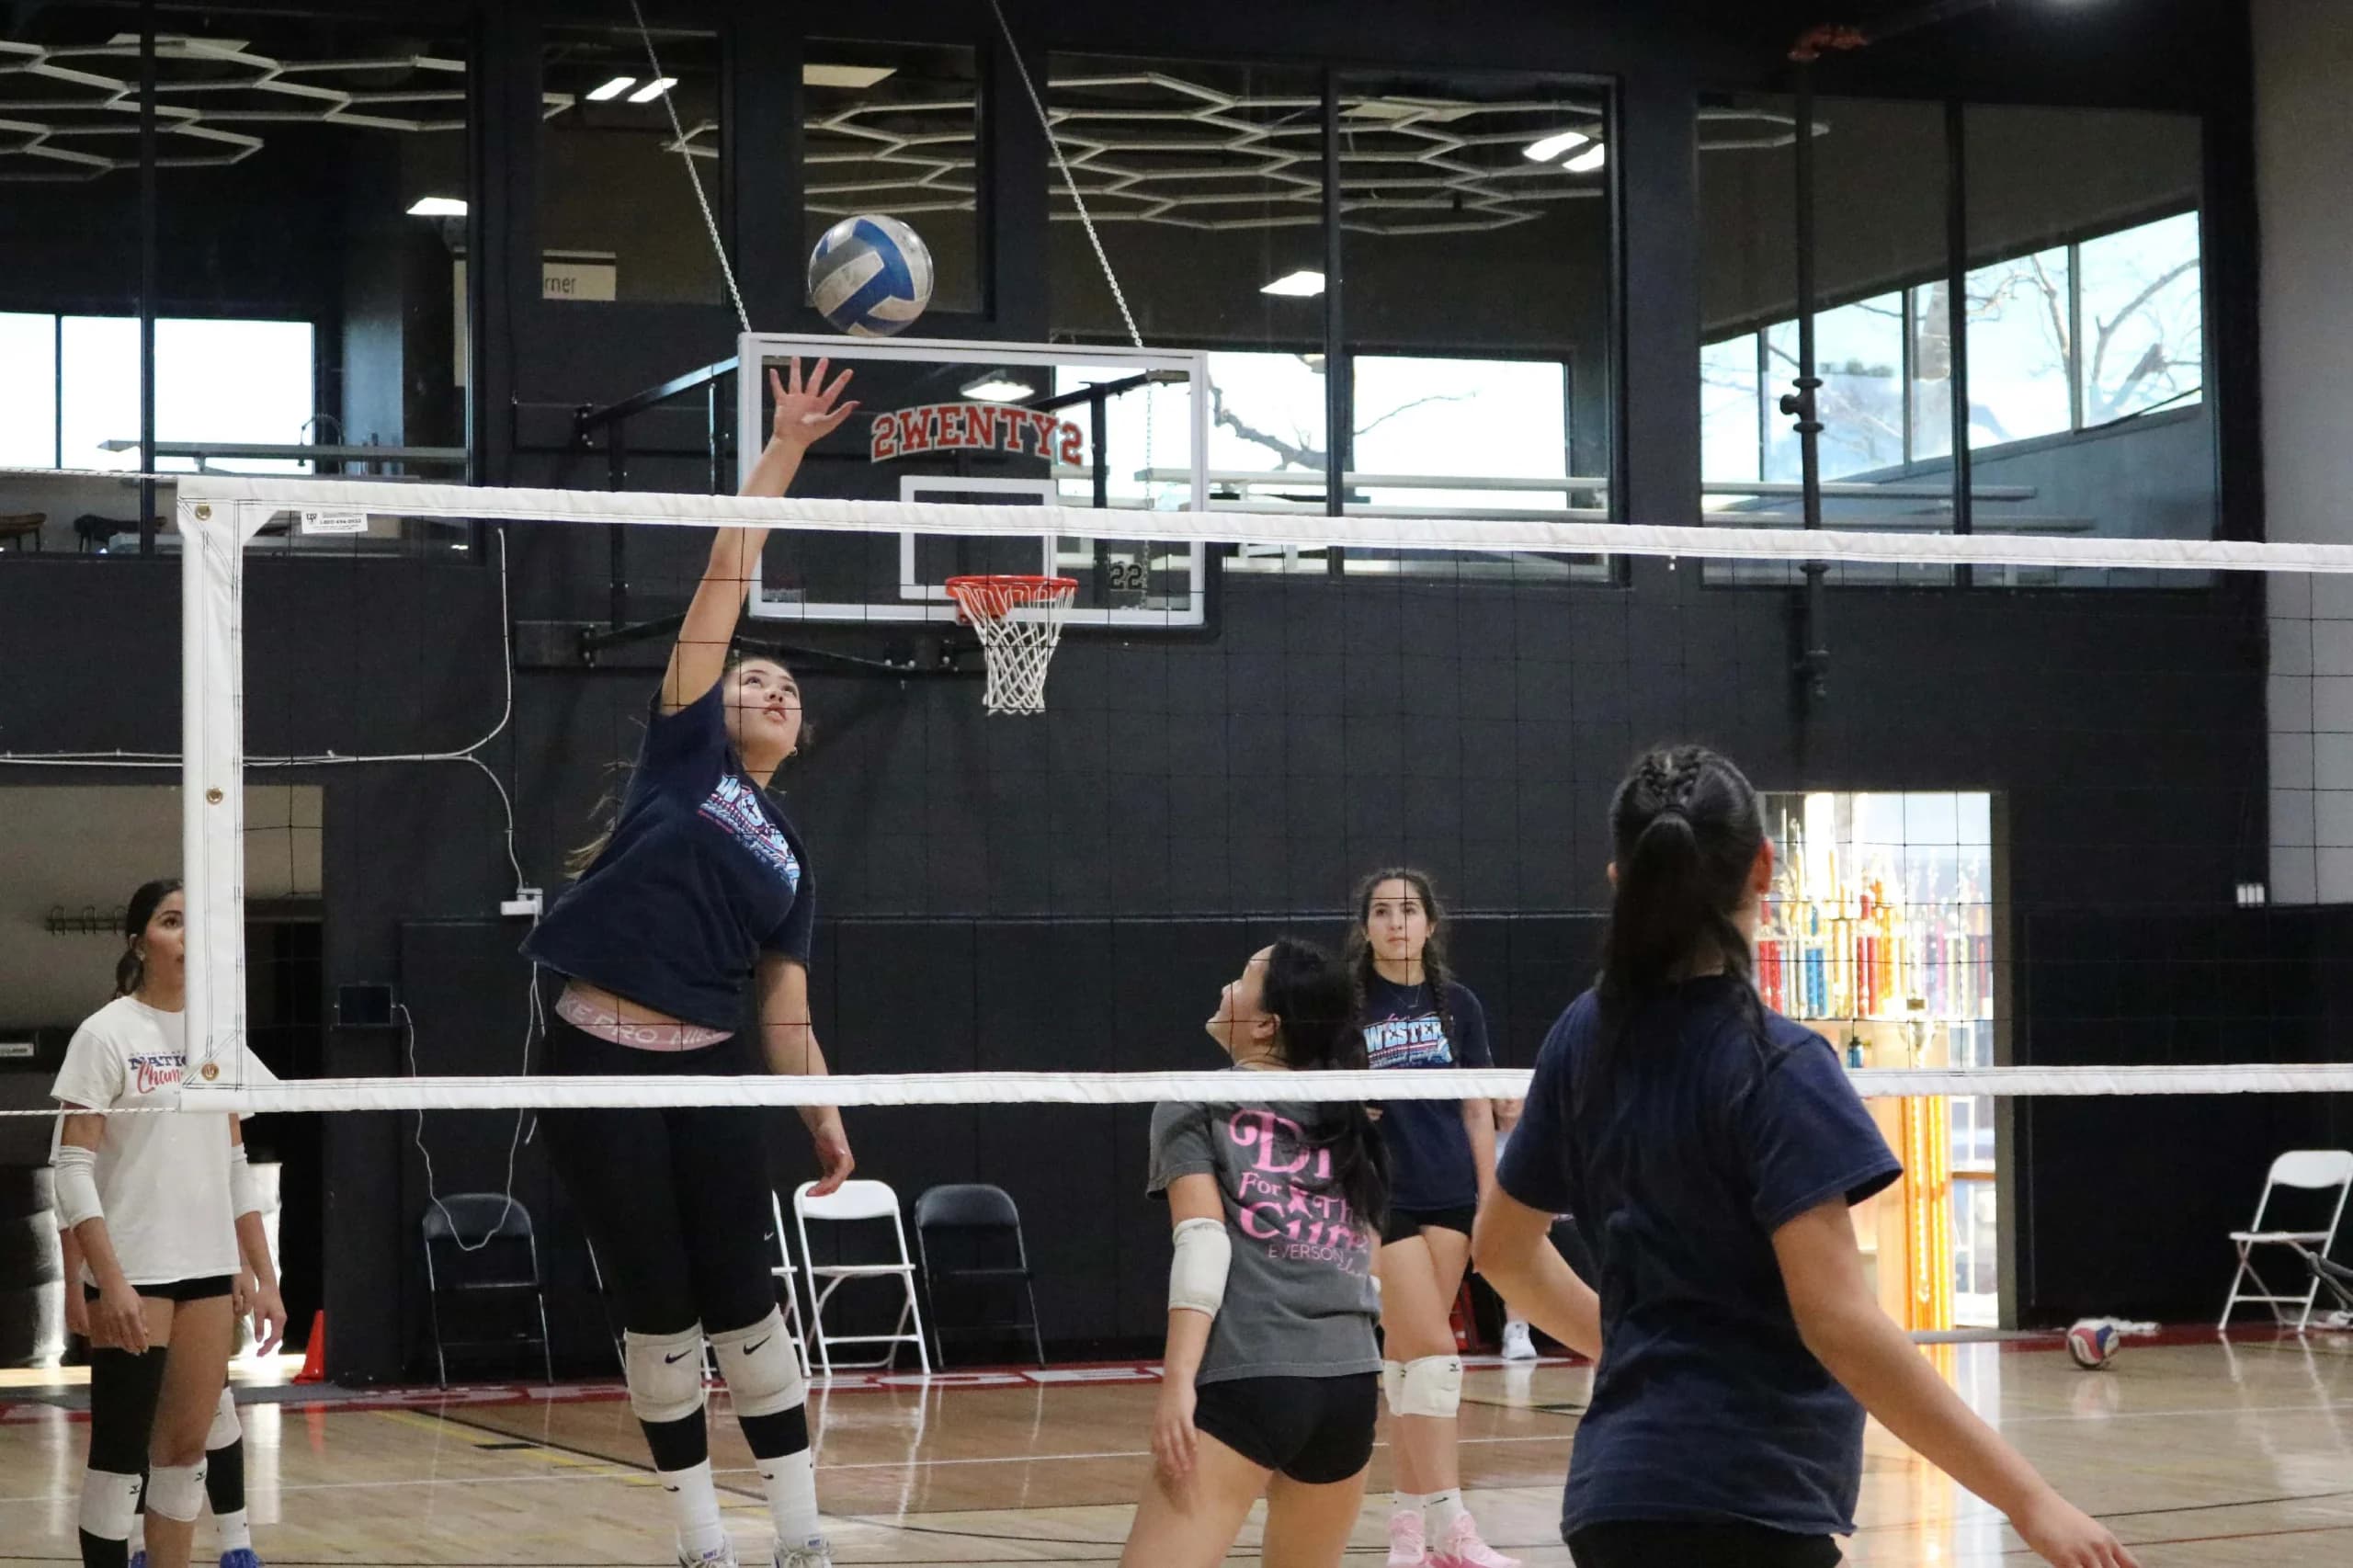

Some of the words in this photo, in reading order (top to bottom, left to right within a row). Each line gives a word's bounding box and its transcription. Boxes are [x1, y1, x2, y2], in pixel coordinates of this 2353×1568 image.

[870, 401, 1083, 464] 2WENTY2
[137, 1062, 182, 1094] Cham
[1230, 1108, 1333, 1179] Di
[1237, 1171, 1282, 1200] For
